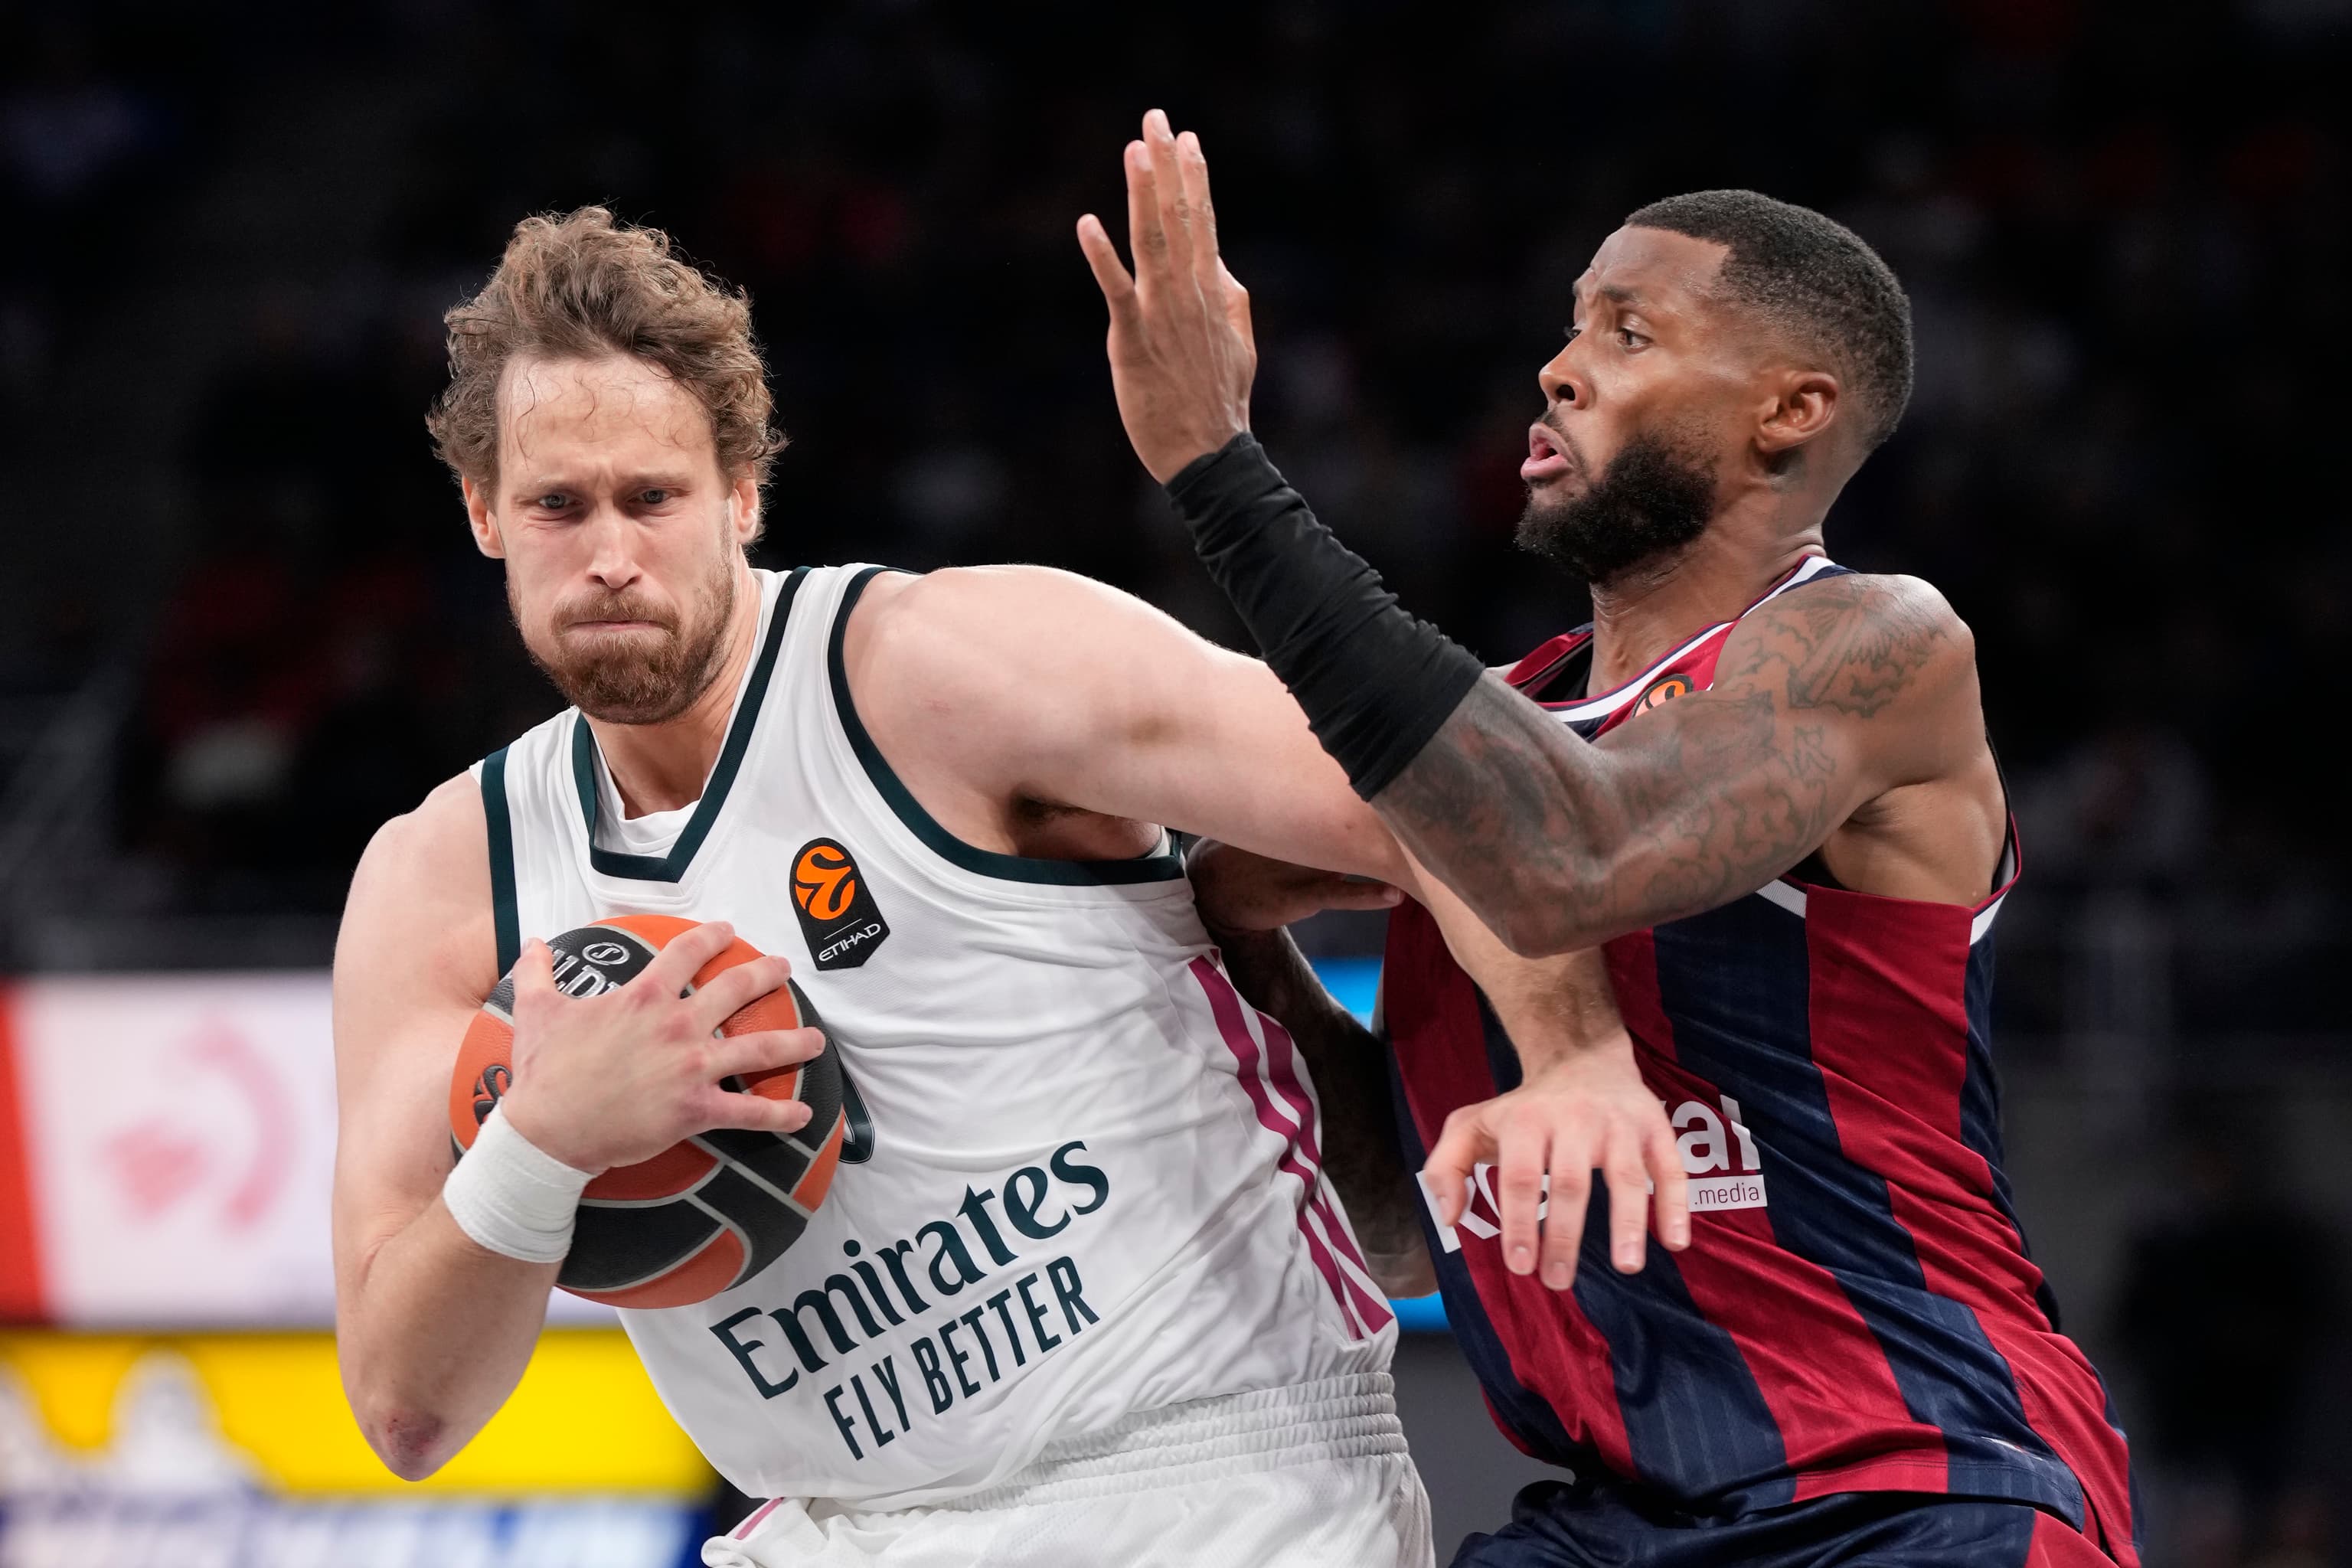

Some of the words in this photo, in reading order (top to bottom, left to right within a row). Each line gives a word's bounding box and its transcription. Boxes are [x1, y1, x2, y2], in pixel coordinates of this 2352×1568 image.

[818, 923, 881, 962] ETIHAD
[1694, 1182, 1759, 1205] .media
[708, 1140, 1109, 1400] Emirates
[823, 1354, 911, 1461] FLY
[910, 1256, 1100, 1416] BETTER
